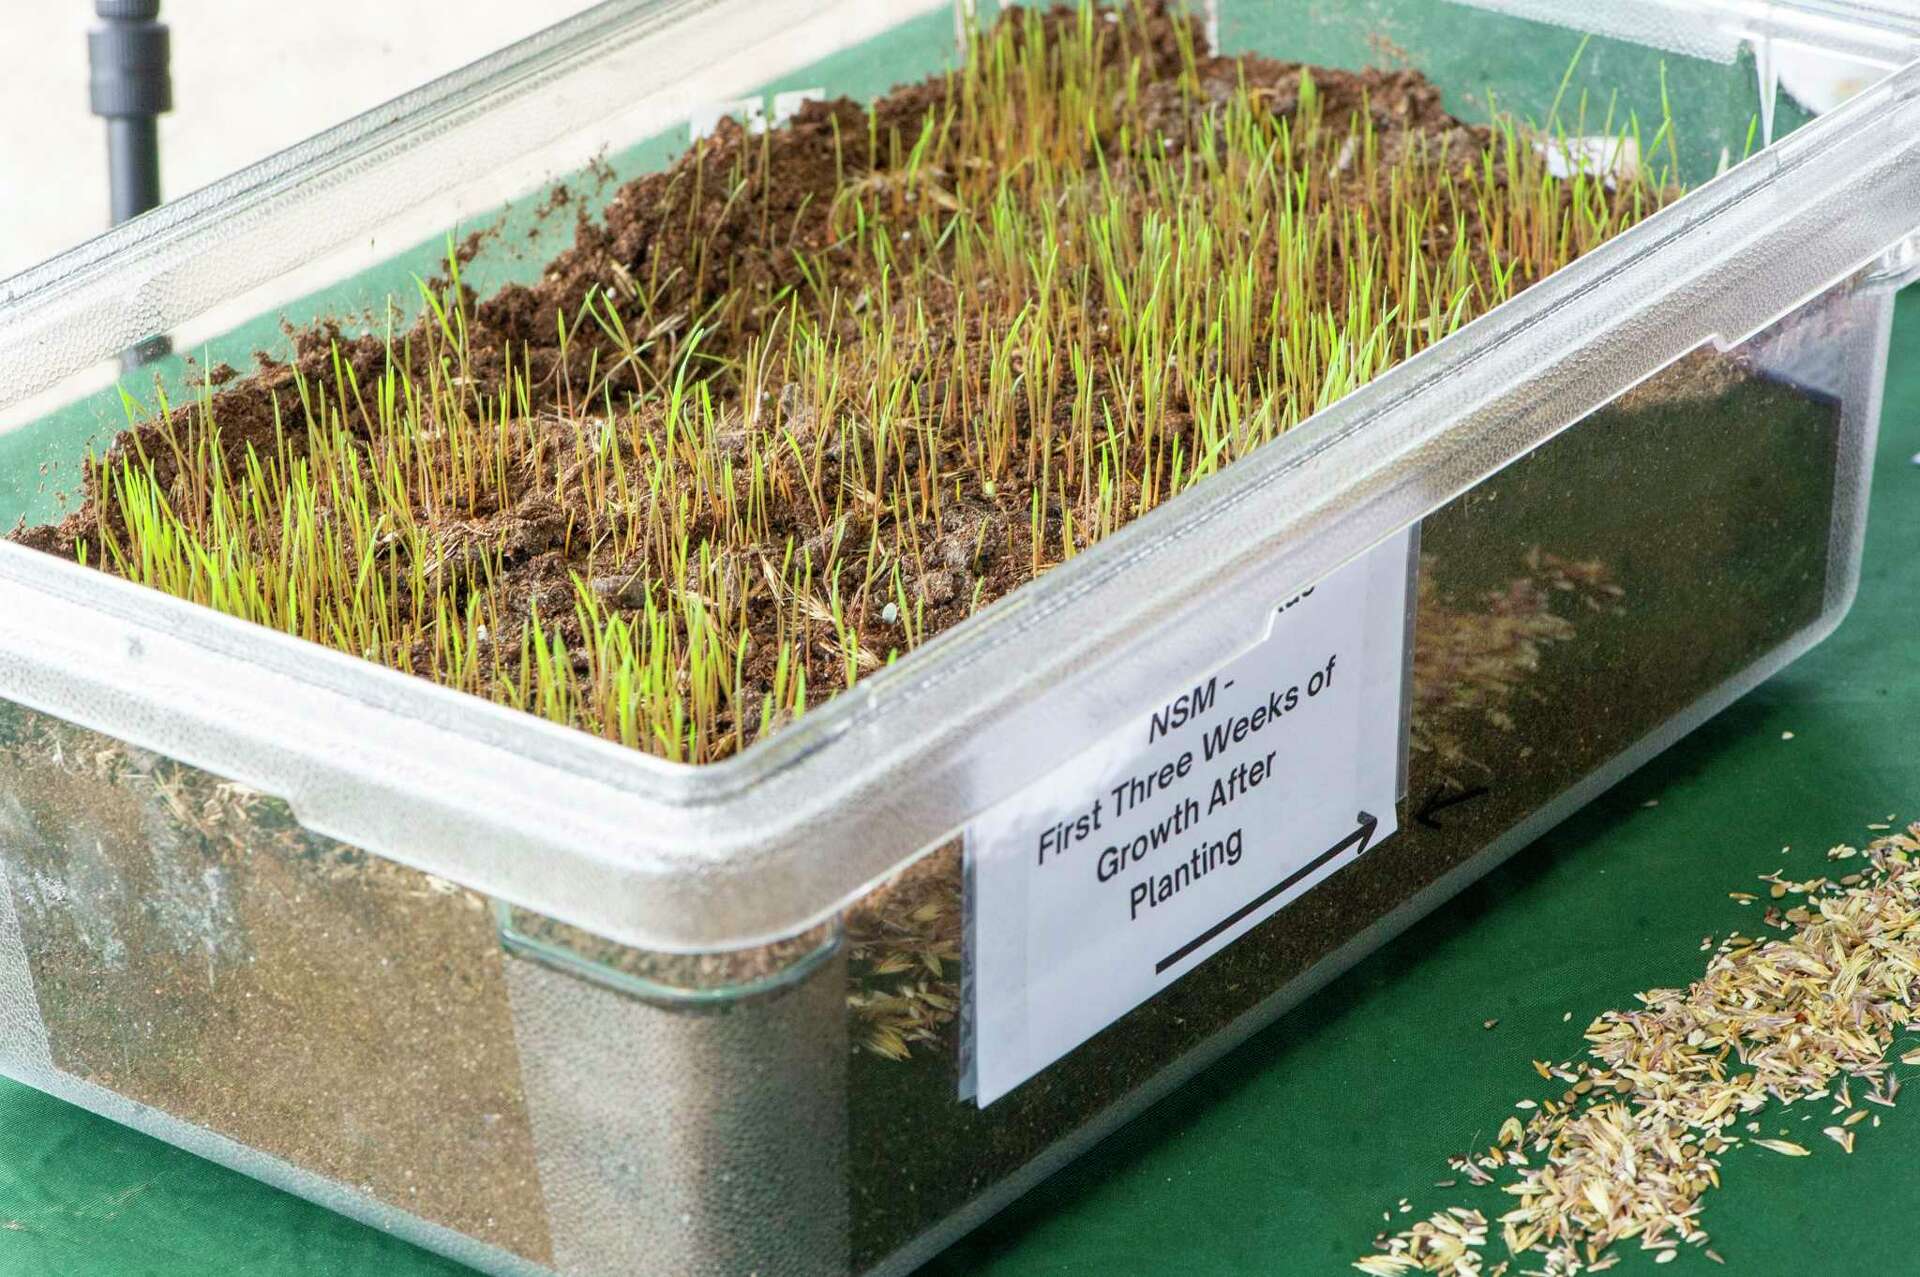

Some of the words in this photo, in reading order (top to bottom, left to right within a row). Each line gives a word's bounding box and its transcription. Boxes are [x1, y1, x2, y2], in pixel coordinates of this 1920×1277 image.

[1038, 799, 1103, 866] First
[1111, 751, 1193, 818] Three
[1202, 685, 1299, 762] Weeks
[1307, 654, 1337, 697] of
[1148, 676, 1217, 745] NSM
[1096, 797, 1201, 883] Growth
[1207, 750, 1277, 817] After
[1130, 827, 1243, 921] Planting
